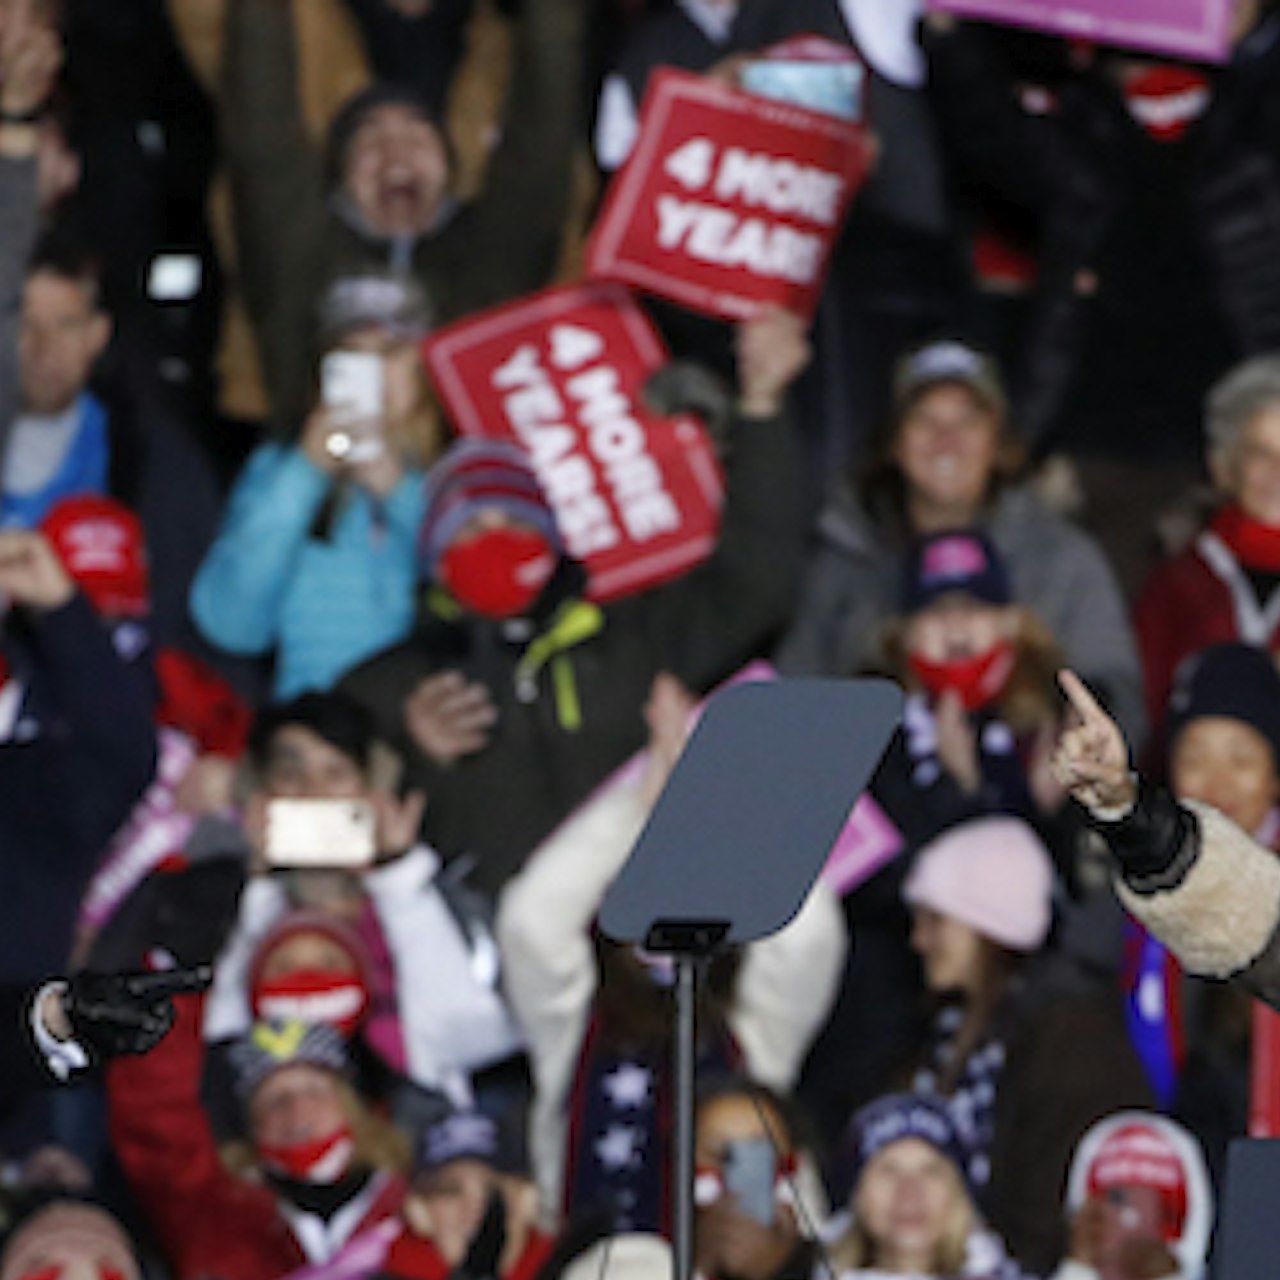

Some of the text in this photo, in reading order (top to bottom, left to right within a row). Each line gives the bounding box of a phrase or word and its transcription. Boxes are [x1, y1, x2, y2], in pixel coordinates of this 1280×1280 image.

[663, 137, 715, 191] 4
[549, 324, 682, 544] 4 MORE
